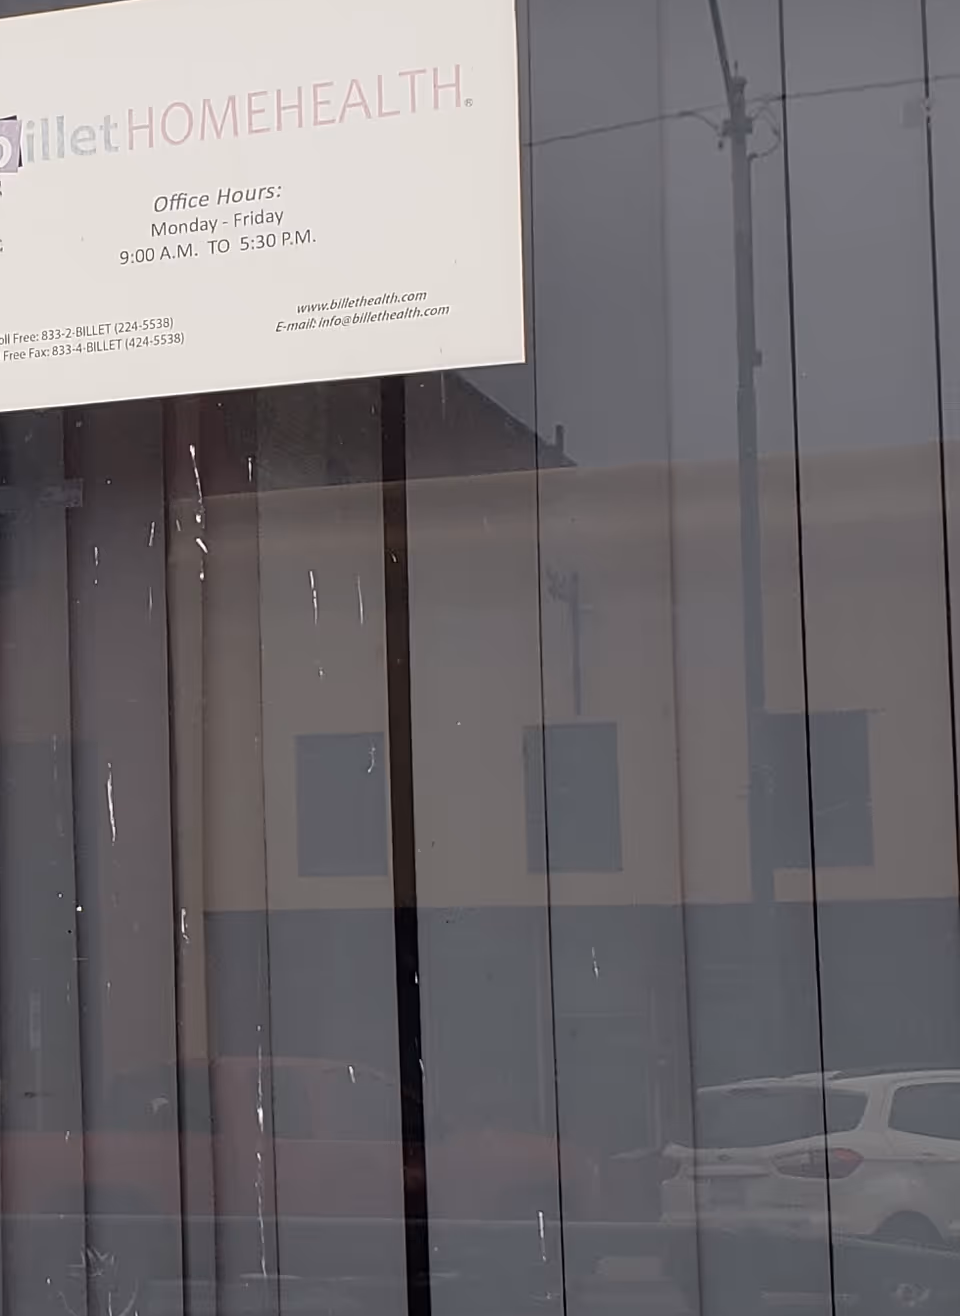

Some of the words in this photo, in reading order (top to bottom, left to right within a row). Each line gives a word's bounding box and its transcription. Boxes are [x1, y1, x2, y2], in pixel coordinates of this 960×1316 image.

[154, 192, 210, 212] Office
[216, 185, 282, 205] Hours:
[151, 217, 218, 237] Monday
[234, 209, 284, 227] Friday
[119, 248, 155, 265] 9:00
[159, 243, 199, 260] A.M.
[207, 239, 230, 254] TO
[239, 233, 276, 251] 5:30
[282, 229, 317, 246] P.M.
[296, 291, 427, 314] www.billethealth.com
[13, 332, 39, 344] Free:
[41, 323, 111, 341] 833-2-BILLET
[114, 317, 174, 335] (224-5538)
[275, 318, 317, 333] E-mail:
[318, 305, 450, 328] info@billethealth.com
[3, 349, 26, 361] Free
[29, 347, 50, 359] Fax:
[52, 339, 122, 356] 833-4-BILLET
[125, 332, 185, 351] (424-5538)
